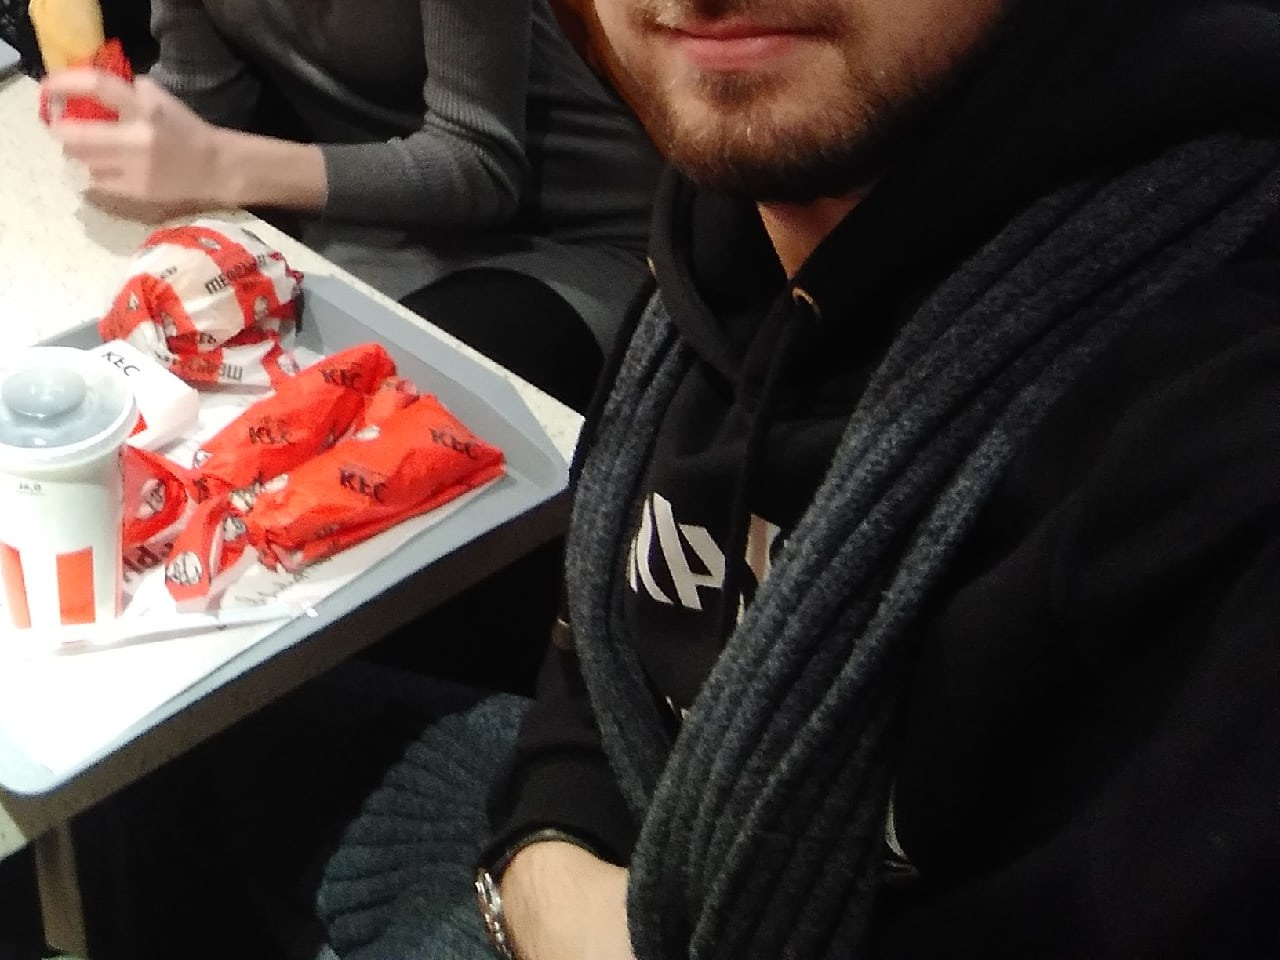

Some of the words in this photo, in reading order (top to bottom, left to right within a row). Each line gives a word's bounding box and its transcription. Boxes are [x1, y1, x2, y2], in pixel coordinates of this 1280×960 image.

[102, 351, 140, 377] KFC
[429, 426, 480, 460] KFC
[339, 464, 388, 502] KFC
